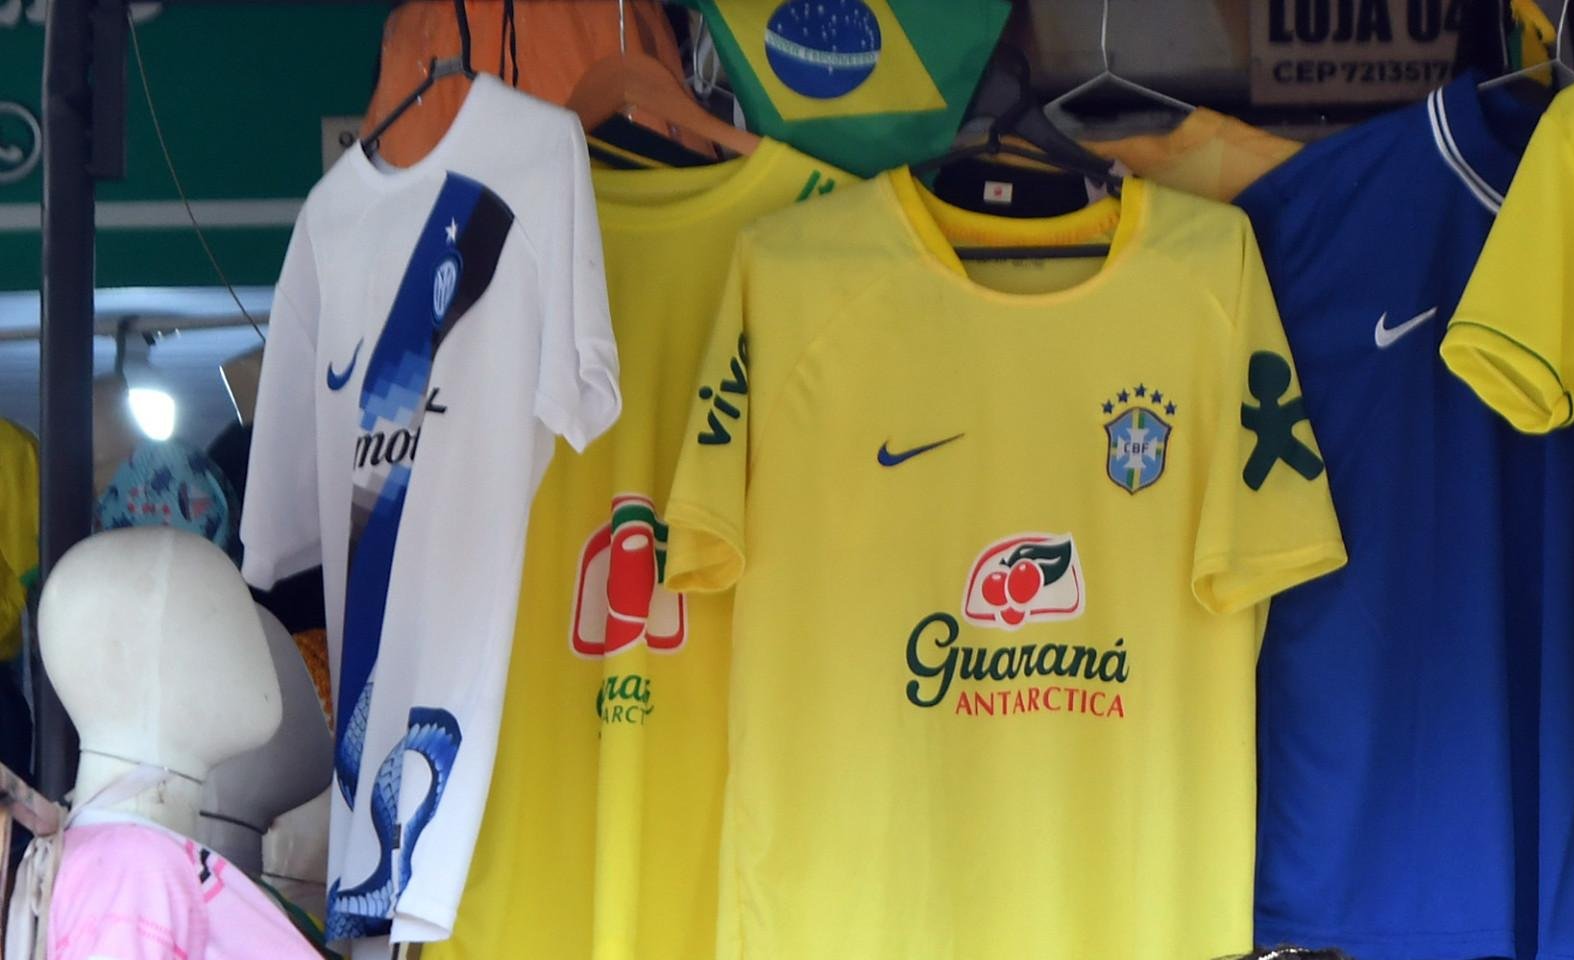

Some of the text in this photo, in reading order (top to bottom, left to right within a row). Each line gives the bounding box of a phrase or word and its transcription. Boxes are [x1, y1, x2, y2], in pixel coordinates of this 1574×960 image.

[1269, 0, 1393, 43] LOJA
[1273, 60, 1458, 84] CEP 7213517
[1123, 442, 1150, 455] CBF
[906, 611, 1130, 708] Guaraná
[955, 686, 1125, 718] ANTARCTICA
